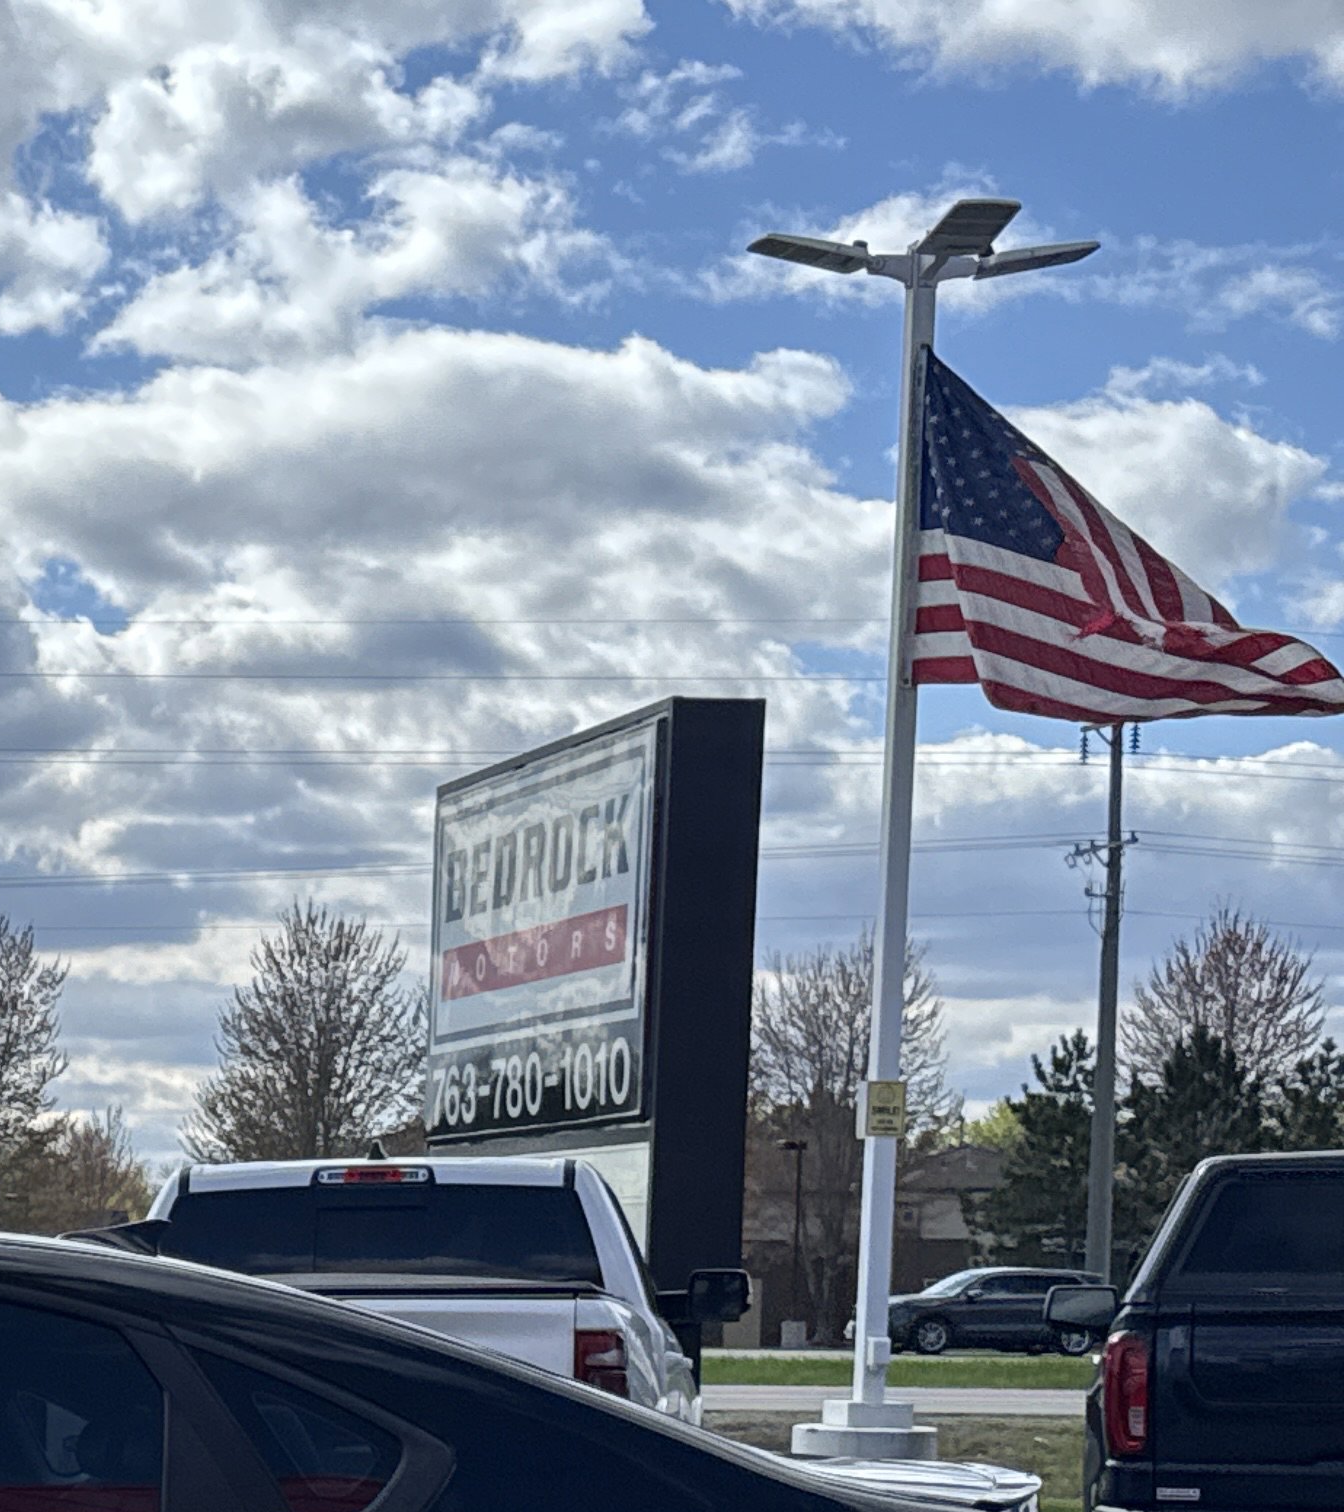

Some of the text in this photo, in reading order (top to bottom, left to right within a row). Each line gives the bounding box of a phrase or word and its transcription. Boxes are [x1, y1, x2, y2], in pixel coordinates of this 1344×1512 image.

[445, 793, 629, 923] BEDROCK
[450, 919, 617, 988] MOTORS
[432, 1036, 630, 1127] 763-780-1010
